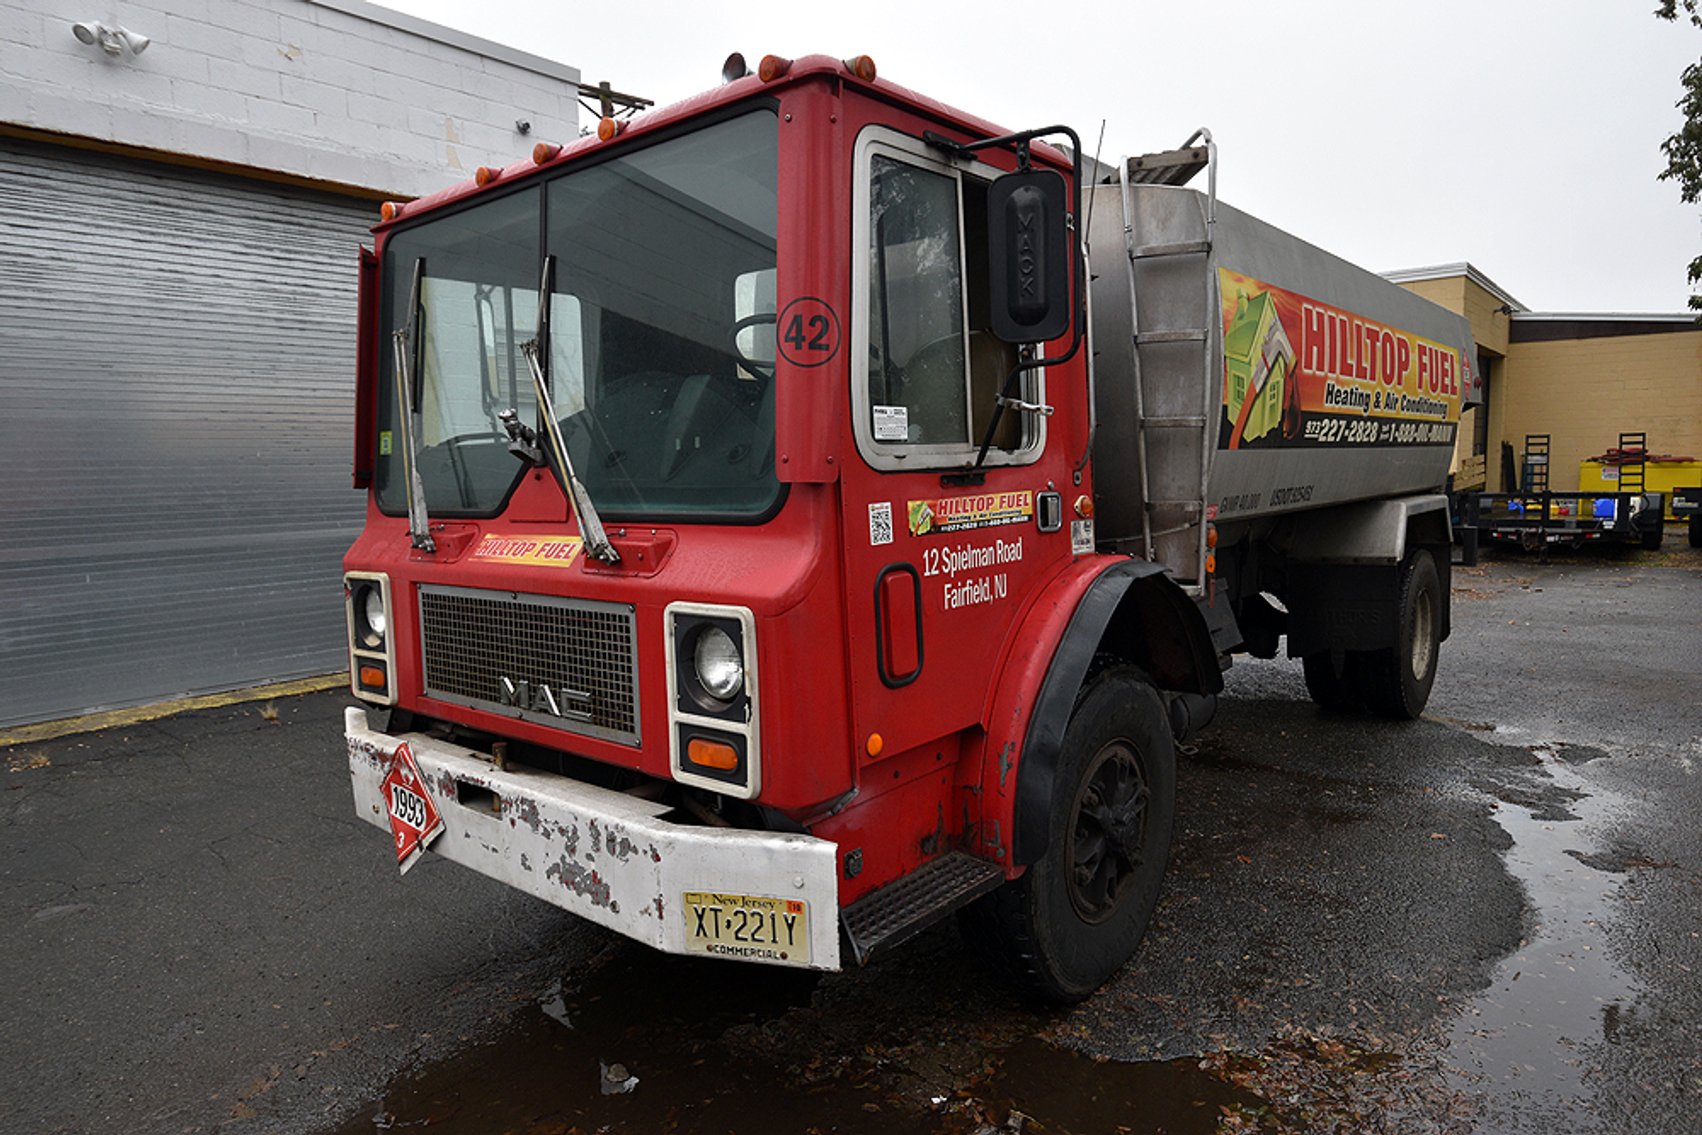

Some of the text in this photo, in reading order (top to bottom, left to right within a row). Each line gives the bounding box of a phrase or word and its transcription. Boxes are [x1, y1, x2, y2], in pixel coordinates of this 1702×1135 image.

[1018, 213, 1034, 296] MACK
[785, 314, 829, 350] 42
[1302, 304, 1458, 396] HILLTOP FUEL
[1326, 383, 1447, 419] Heating & Air Conditioning
[1318, 419, 1379, 442] 227-2828
[938, 493, 1029, 516] HILLTOP FUEL
[477, 540, 577, 559] HILLTOP FUEL
[923, 536, 1022, 577] 12 Spielman Road
[944, 573, 1008, 610] Fairfield, NJ
[393, 786, 425, 828] 1993
[397, 831, 405, 849] 3
[712, 893, 775, 909] New Jersey
[713, 944, 780, 959] COMMERCIAL
